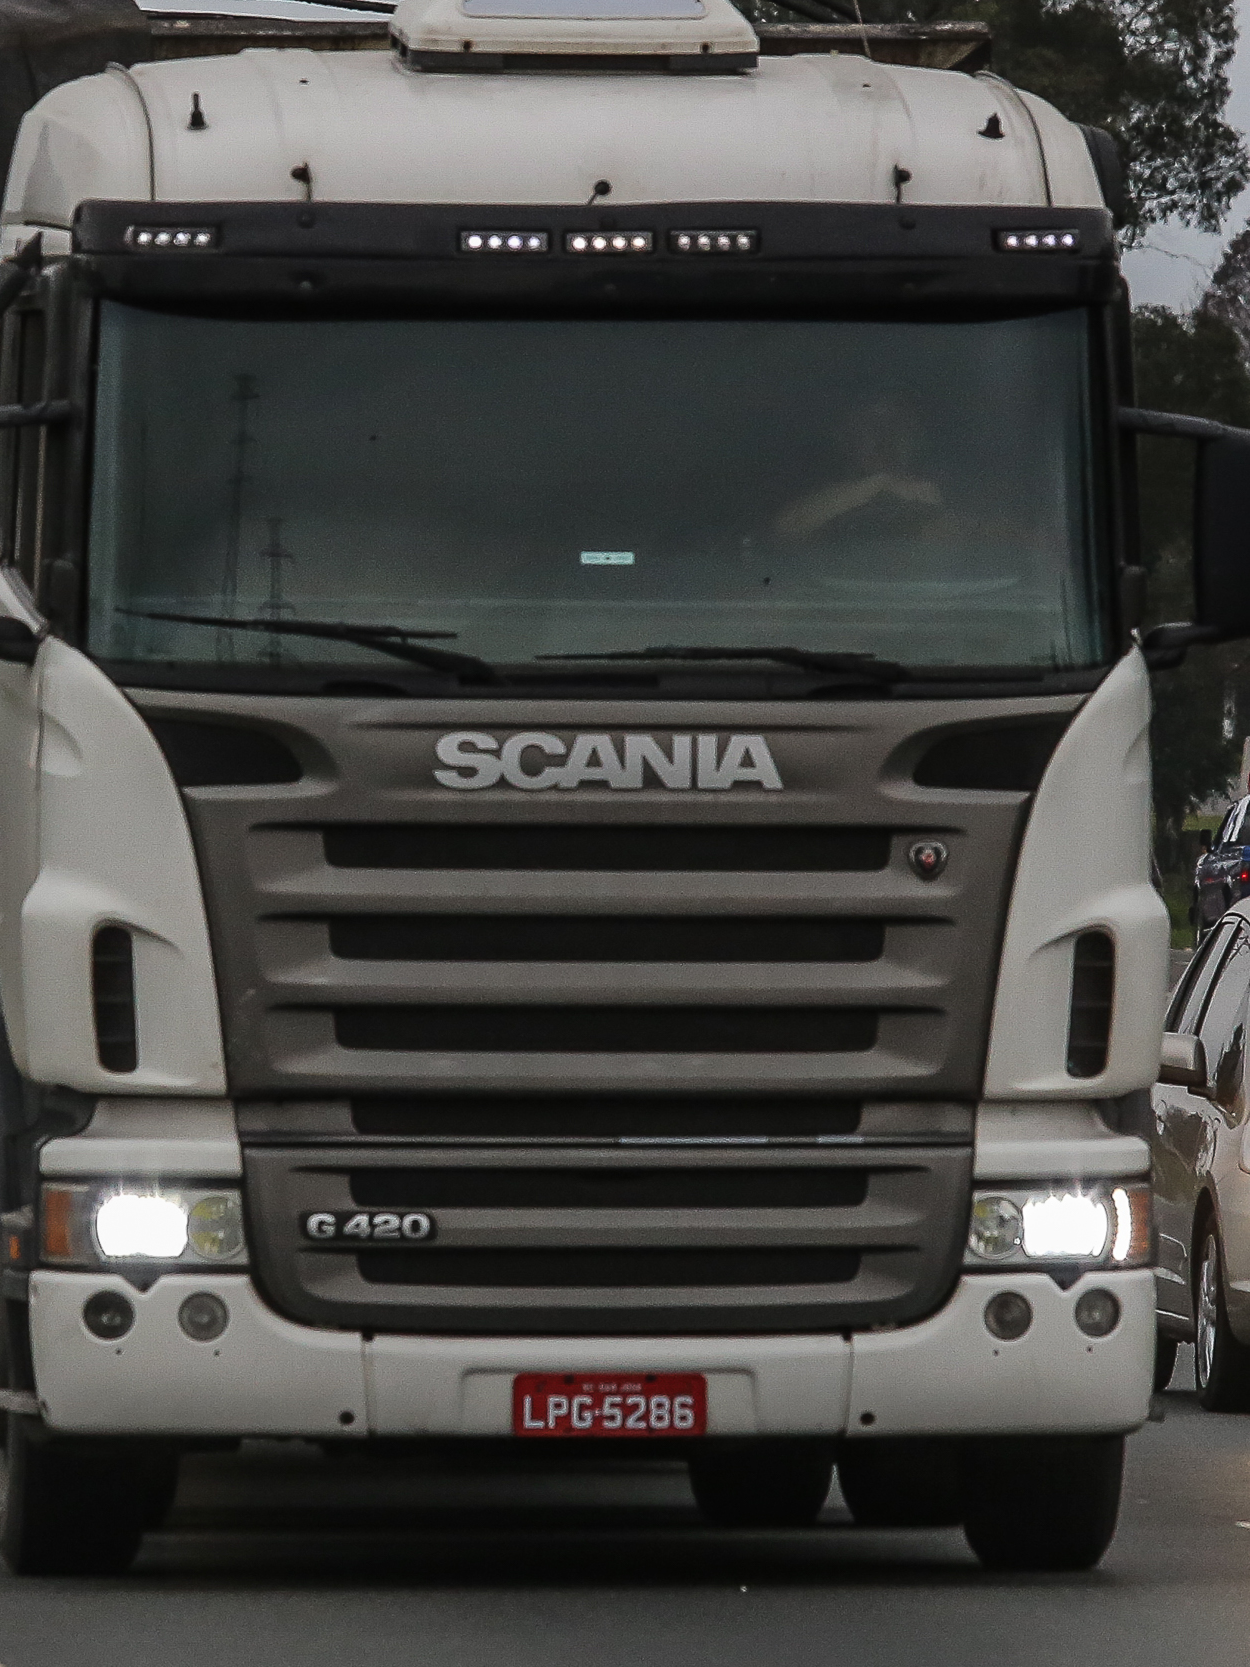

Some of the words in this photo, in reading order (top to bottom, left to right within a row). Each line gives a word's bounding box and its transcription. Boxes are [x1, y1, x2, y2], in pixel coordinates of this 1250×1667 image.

[433, 731, 784, 790] SCANIA
[306, 1213, 336, 1239] G
[342, 1213, 431, 1239] 420
